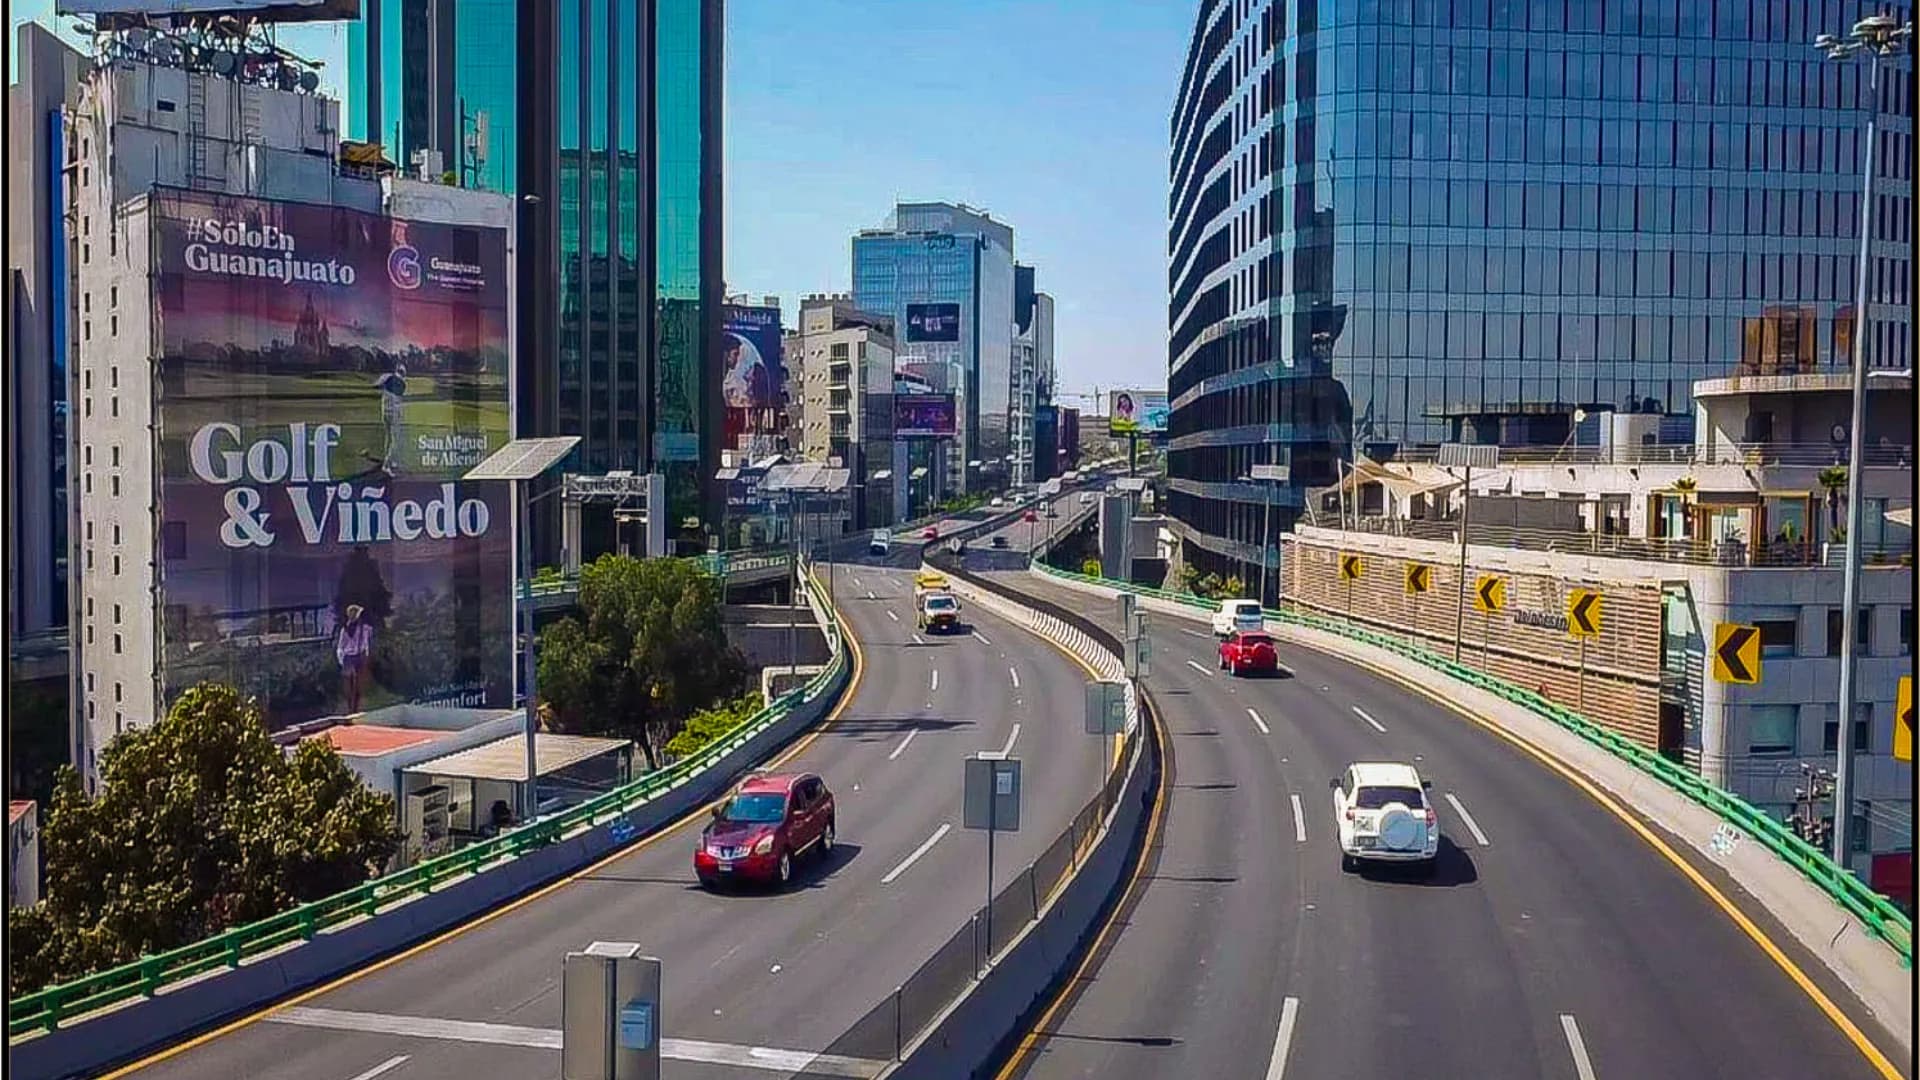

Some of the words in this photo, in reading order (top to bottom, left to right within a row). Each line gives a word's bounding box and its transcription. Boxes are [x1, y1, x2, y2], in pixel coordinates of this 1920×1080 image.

[184, 243, 356, 285] Guanajuato
[189, 421, 341, 484] Golf
[418, 434, 443, 450] San
[444, 433, 488, 453] Miguel
[421, 451, 438, 466] de
[440, 452, 486, 466] Allend
[219, 486, 276, 548] &
[285, 482, 490, 544] Viñedo
